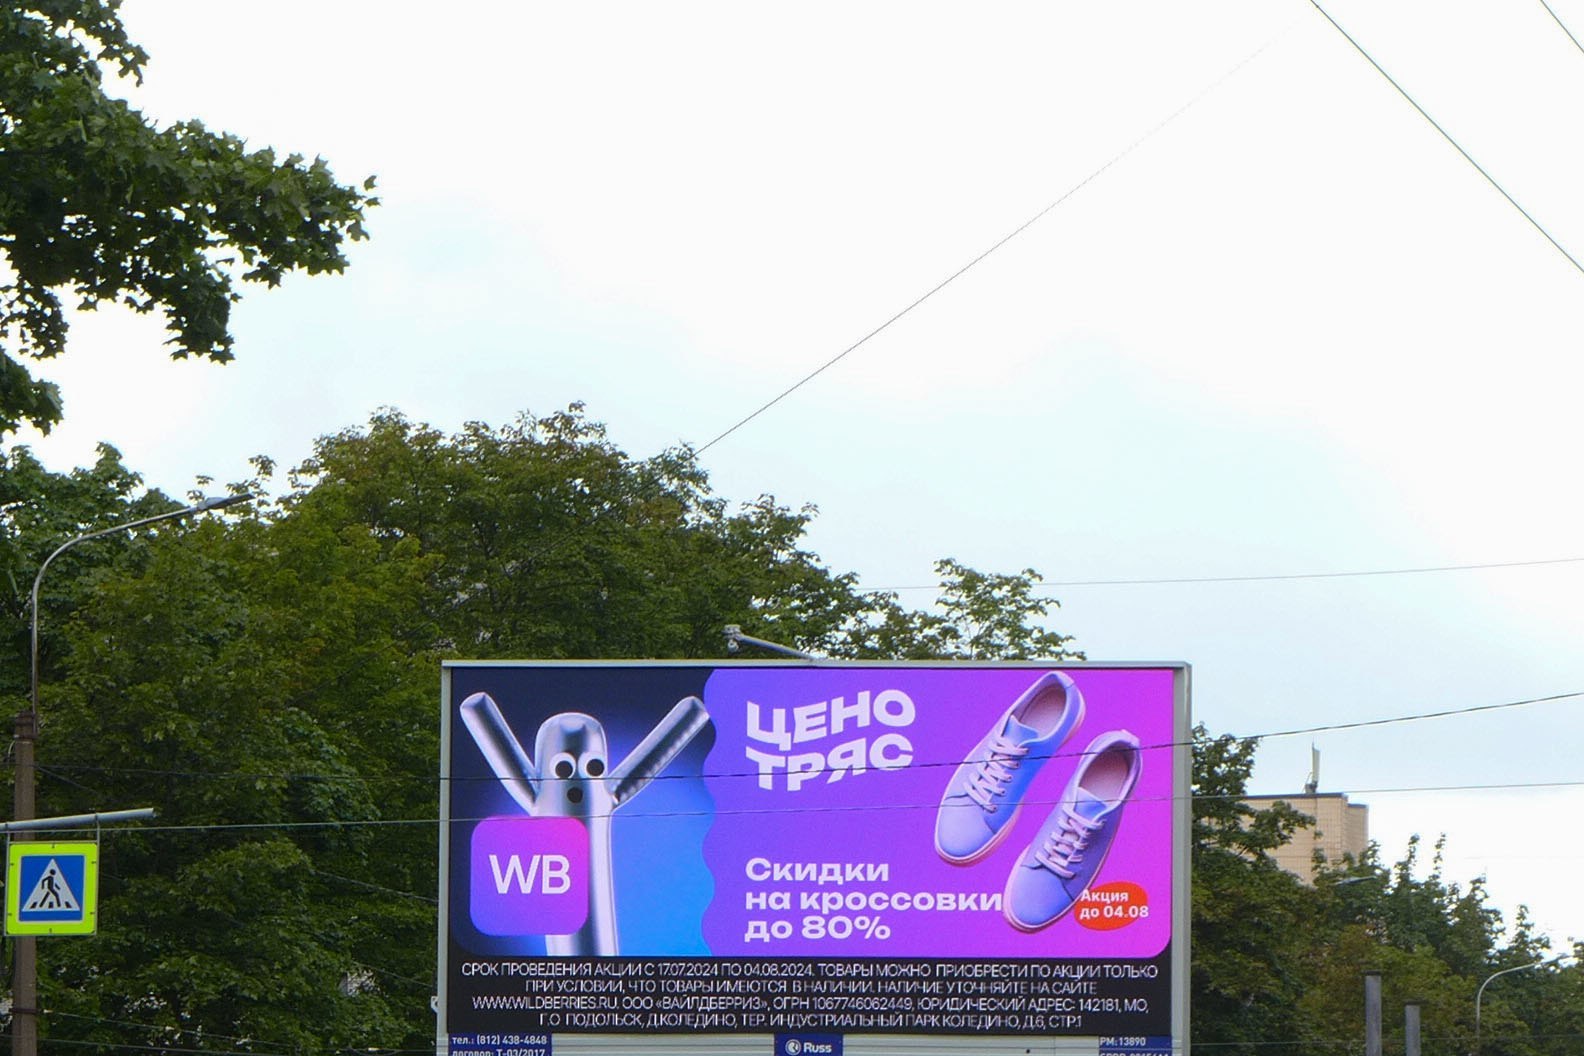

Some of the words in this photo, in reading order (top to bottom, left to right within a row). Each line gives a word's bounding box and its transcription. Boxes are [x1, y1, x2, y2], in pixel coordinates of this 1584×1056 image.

[747, 689, 916, 751] ЦЕНО
[745, 733, 914, 792] ТРЯС
[489, 854, 571, 894] WB
[745, 857, 889, 885] Скидки
[745, 891, 791, 911] на
[800, 891, 1002, 914] кроссовки
[1080, 888, 1129, 904] Акция
[1080, 907, 1100, 920] до
[1103, 905, 1149, 918] 04.08
[744, 920, 793, 942] до
[801, 915, 891, 940] 80%
[461, 963, 499, 976] СРОК
[502, 963, 592, 978] ПРОВЕДЕНИЯ
[594, 963, 641, 978] АКЦИИ
[644, 963, 655, 976] С
[721, 963, 741, 976] ПО
[818, 963, 872, 976] ТОВАРЫ
[876, 963, 930, 976] МОЖНО
[936, 963, 1027, 976] ПРИОБРЕСТИ
[1030, 964, 1050, 977] ПО
[1053, 964, 1100, 979] АКЦИИ
[1103, 964, 1158, 977] ТОЛЬКО
[526, 980, 553, 993] ПРИ
[557, 980, 625, 995] УСЛОВИИ,
[628, 980, 656, 993] ЧТО
[660, 980, 713, 993] ТОВАРЫ
[716, 980, 786, 993] ИМЕЮТСЯ
[793, 980, 801, 993] В
[878, 980, 943, 993] НАЛИЧИЕ
[946, 977, 1027, 993] УТОЧНЯЙТЕ
[1031, 981, 1049, 994] НА
[1052, 978, 1096, 994] САЙТЕ
[622, 996, 653, 1009] ООО
[773, 997, 809, 1010] ОГРН
[917, 994, 1025, 1012] ЮРИДИЧЕСКИЙ
[1079, 997, 1121, 1013] 142181,
[1124, 997, 1149, 1013] МО,
[566, 1013, 644, 1028] ПОДОЛЬСК,
[647, 1013, 738, 1028] Д.КОЛЕДИНО,
[770, 1010, 903, 1029] ИНДУСТРИАЛЬНЫЙ
[906, 1013, 940, 1026] ПАРК
[942, 1013, 1021, 1029] КОЛЕДИНО,
[476, 1034, 500, 1046] (812)
[502, 1034, 547, 1046] 438-4848
[803, 1042, 832, 1054] Russ
